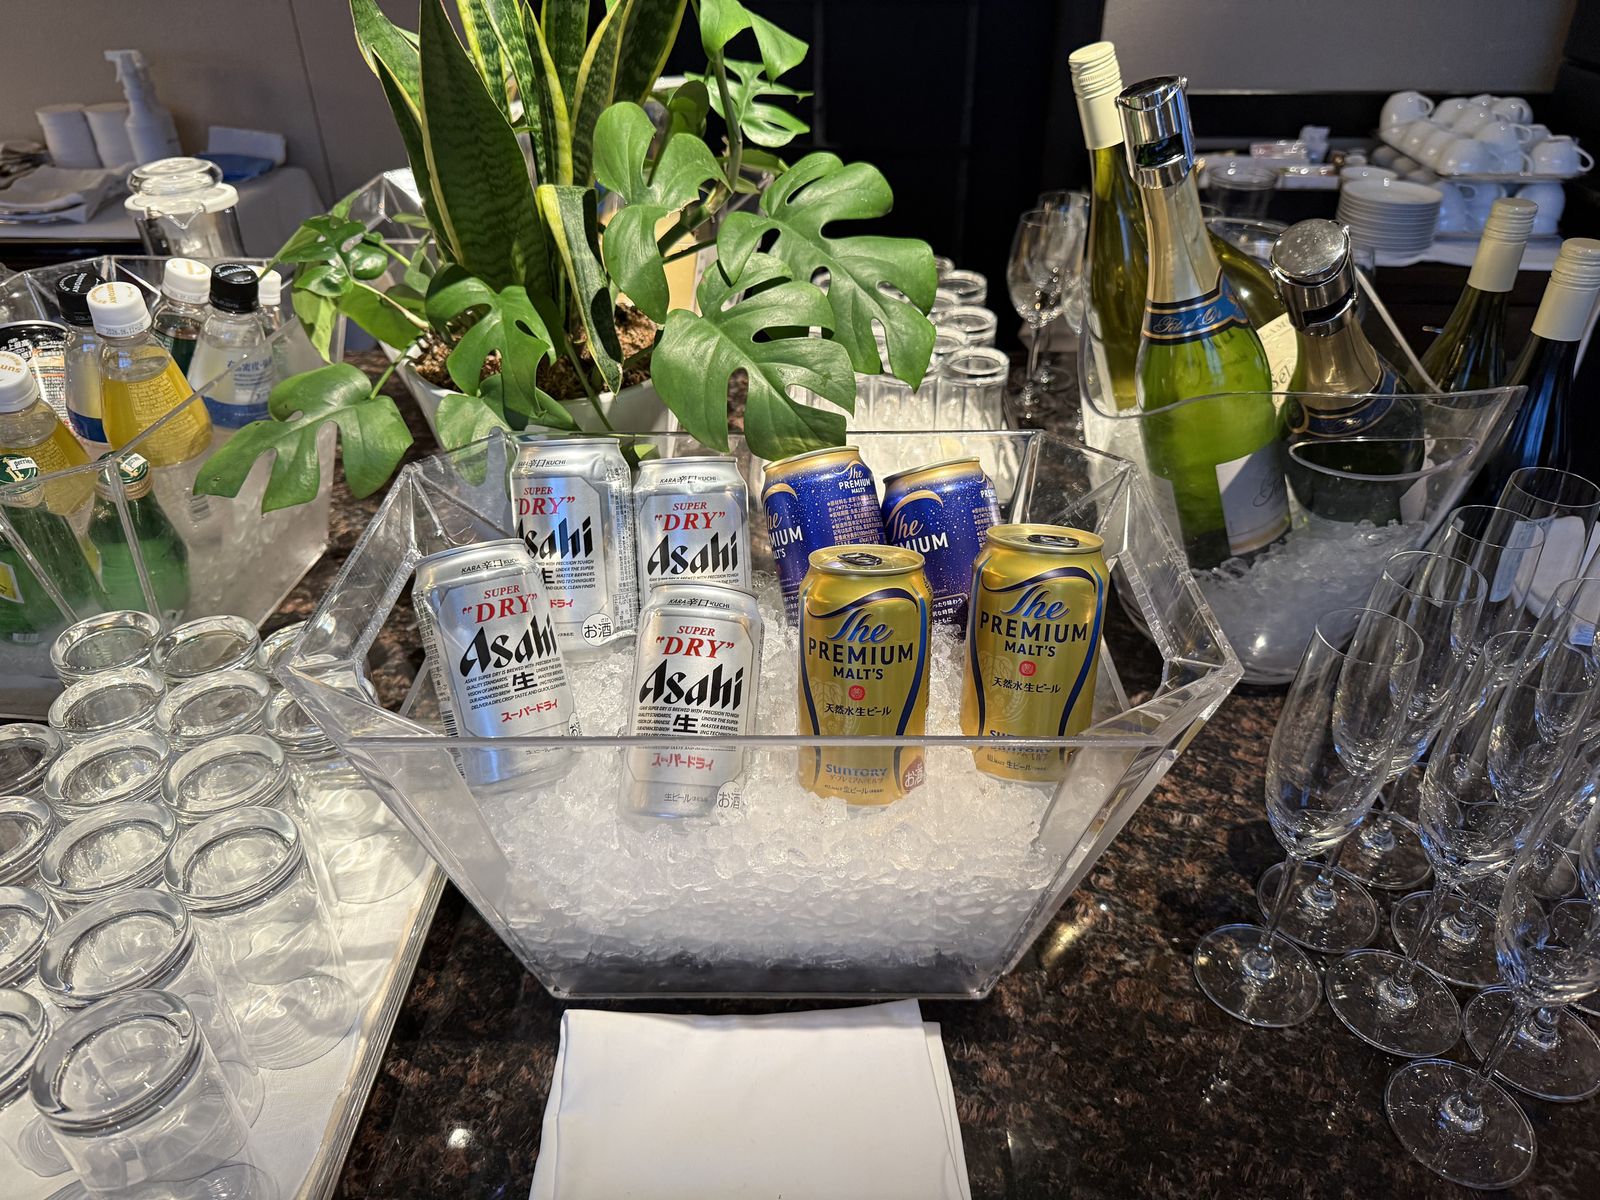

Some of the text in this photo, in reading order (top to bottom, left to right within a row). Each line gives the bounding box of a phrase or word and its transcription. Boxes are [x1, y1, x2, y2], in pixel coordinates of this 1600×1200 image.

[524, 486, 554, 495] SUPER
[839, 478, 871, 490] PREMIUM
[672, 501, 707, 511] SUPER
[655, 511, 726, 531] "DRY"
[890, 508, 924, 543] The
[769, 526, 804, 548] MIUM
[647, 531, 738, 576] Asahi
[461, 564, 481, 575] KARA
[484, 585, 520, 599] SUPER
[462, 593, 538, 623] "DRY"
[550, 598, 574, 608] ドライ
[708, 601, 731, 609] KUCHI
[1000, 584, 1070, 621] The
[584, 623, 611, 638] お酒
[677, 625, 716, 637] SUPER
[825, 608, 894, 645] The
[980, 611, 1088, 643] PREMIUM
[460, 613, 557, 677] Asahi
[655, 636, 735, 658] "DRY"
[808, 637, 914, 665] PREMIUM
[1004, 640, 1056, 657] MALT'S
[512, 672, 539, 692] 生
[833, 666, 884, 680] MALT'S
[639, 659, 743, 710] Asahi
[992, 677, 1061, 693] 天然水生ビール
[500, 698, 558, 723] スーパードライ
[824, 703, 892, 717] 天然水生ビール
[673, 714, 699, 734] 生
[651, 752, 715, 771] スーパードライ
[825, 763, 888, 777] SUNTORY
